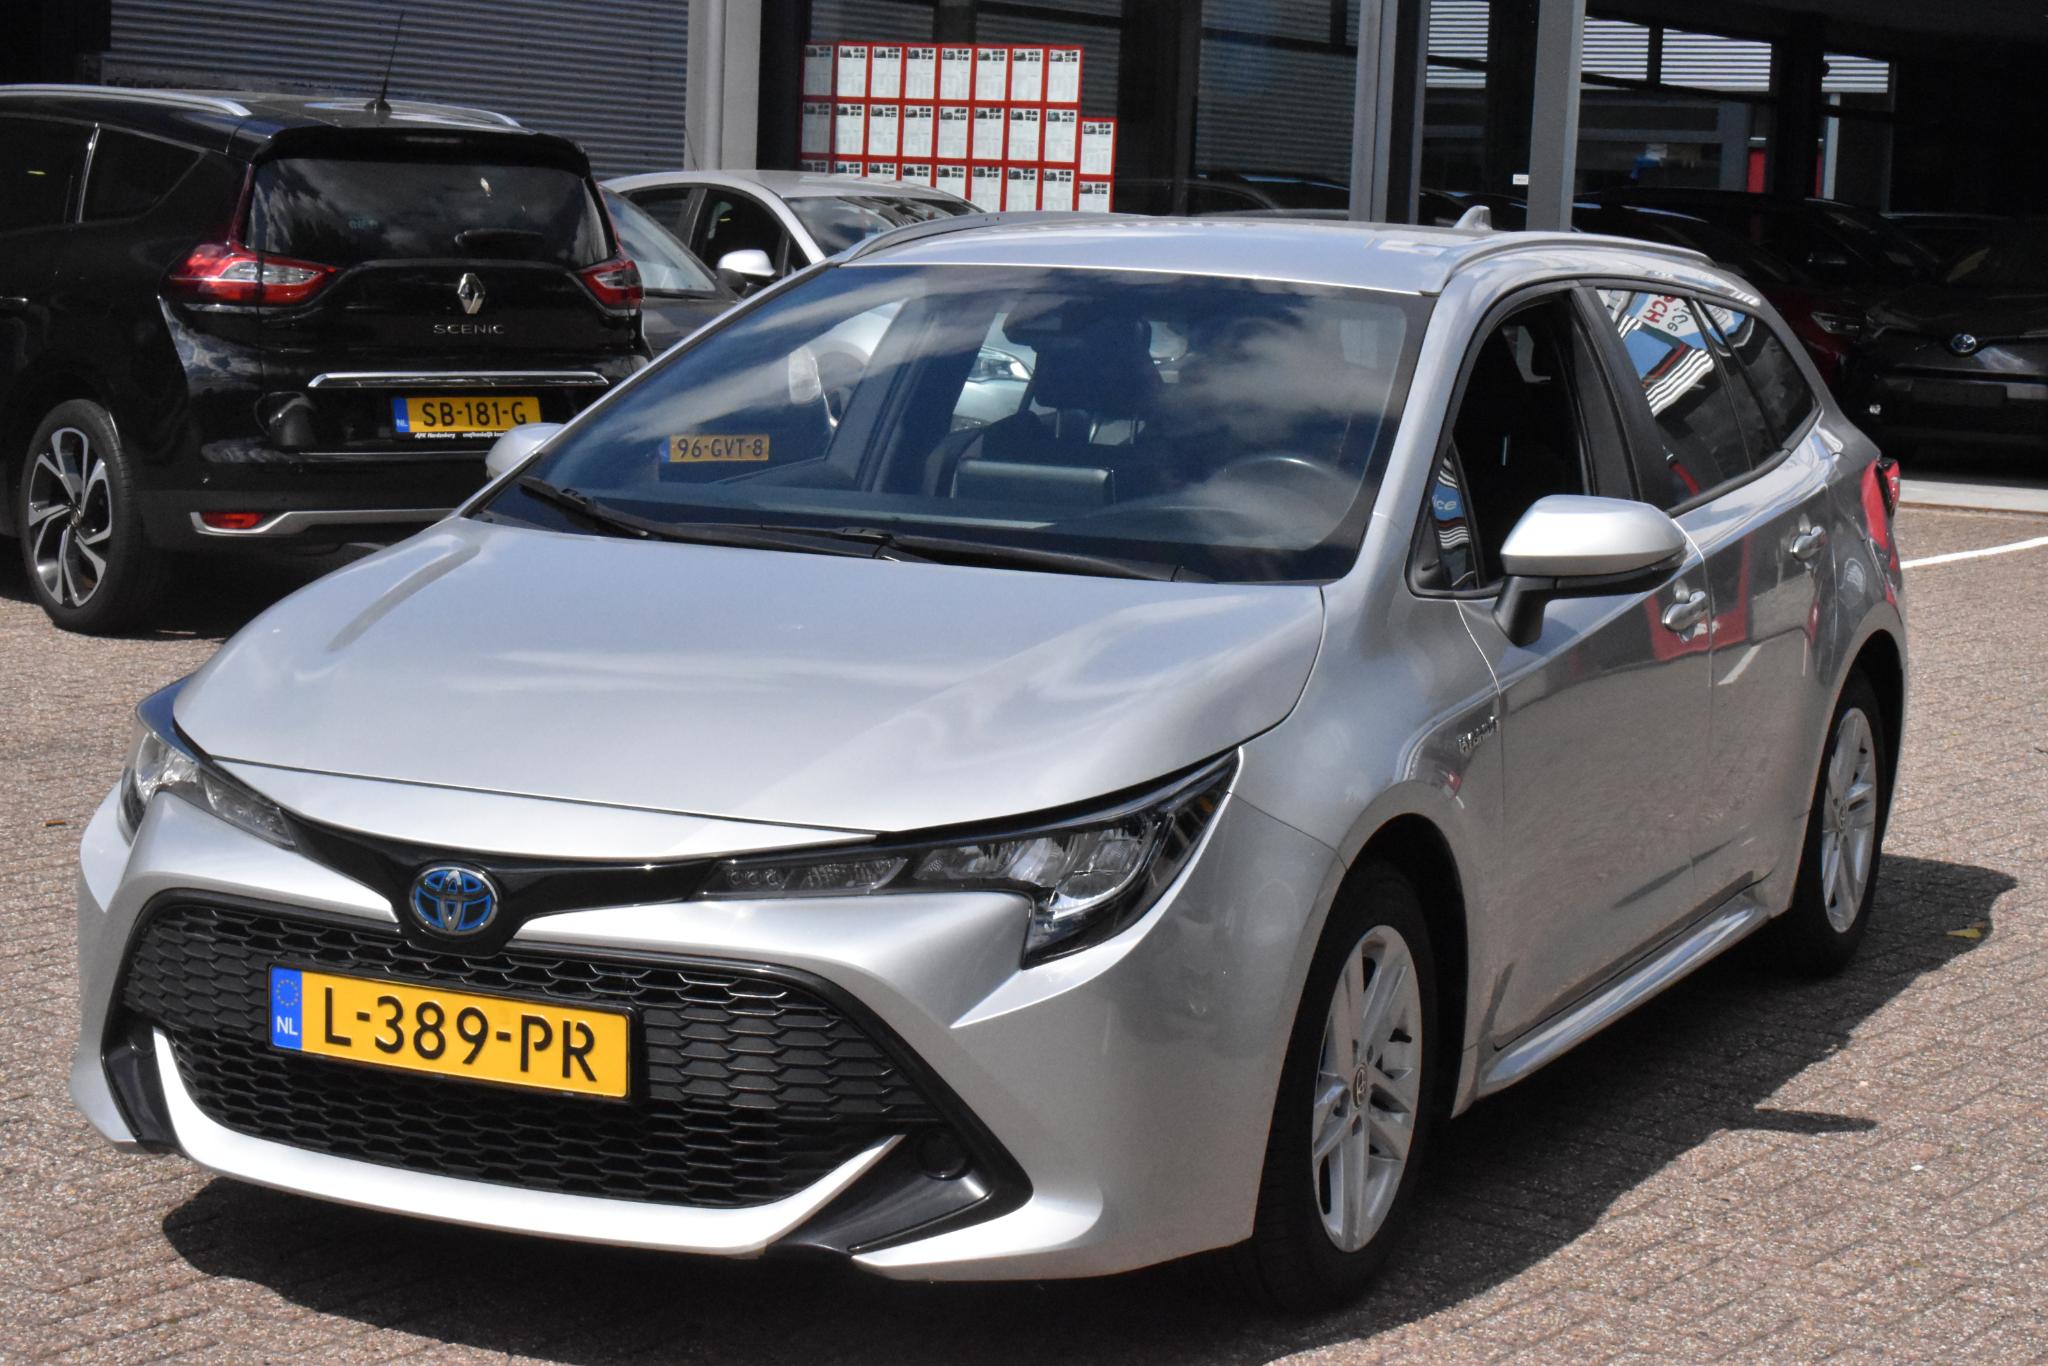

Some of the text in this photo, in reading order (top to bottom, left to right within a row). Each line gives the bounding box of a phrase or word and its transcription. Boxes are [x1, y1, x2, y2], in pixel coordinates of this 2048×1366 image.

[433, 324, 504, 334] SCENIC
[422, 401, 526, 427] SB-181-G
[677, 438, 762, 458] 96-GVT-8
[276, 1015, 298, 1036] NL
[324, 987, 597, 1082] L-389-PR
